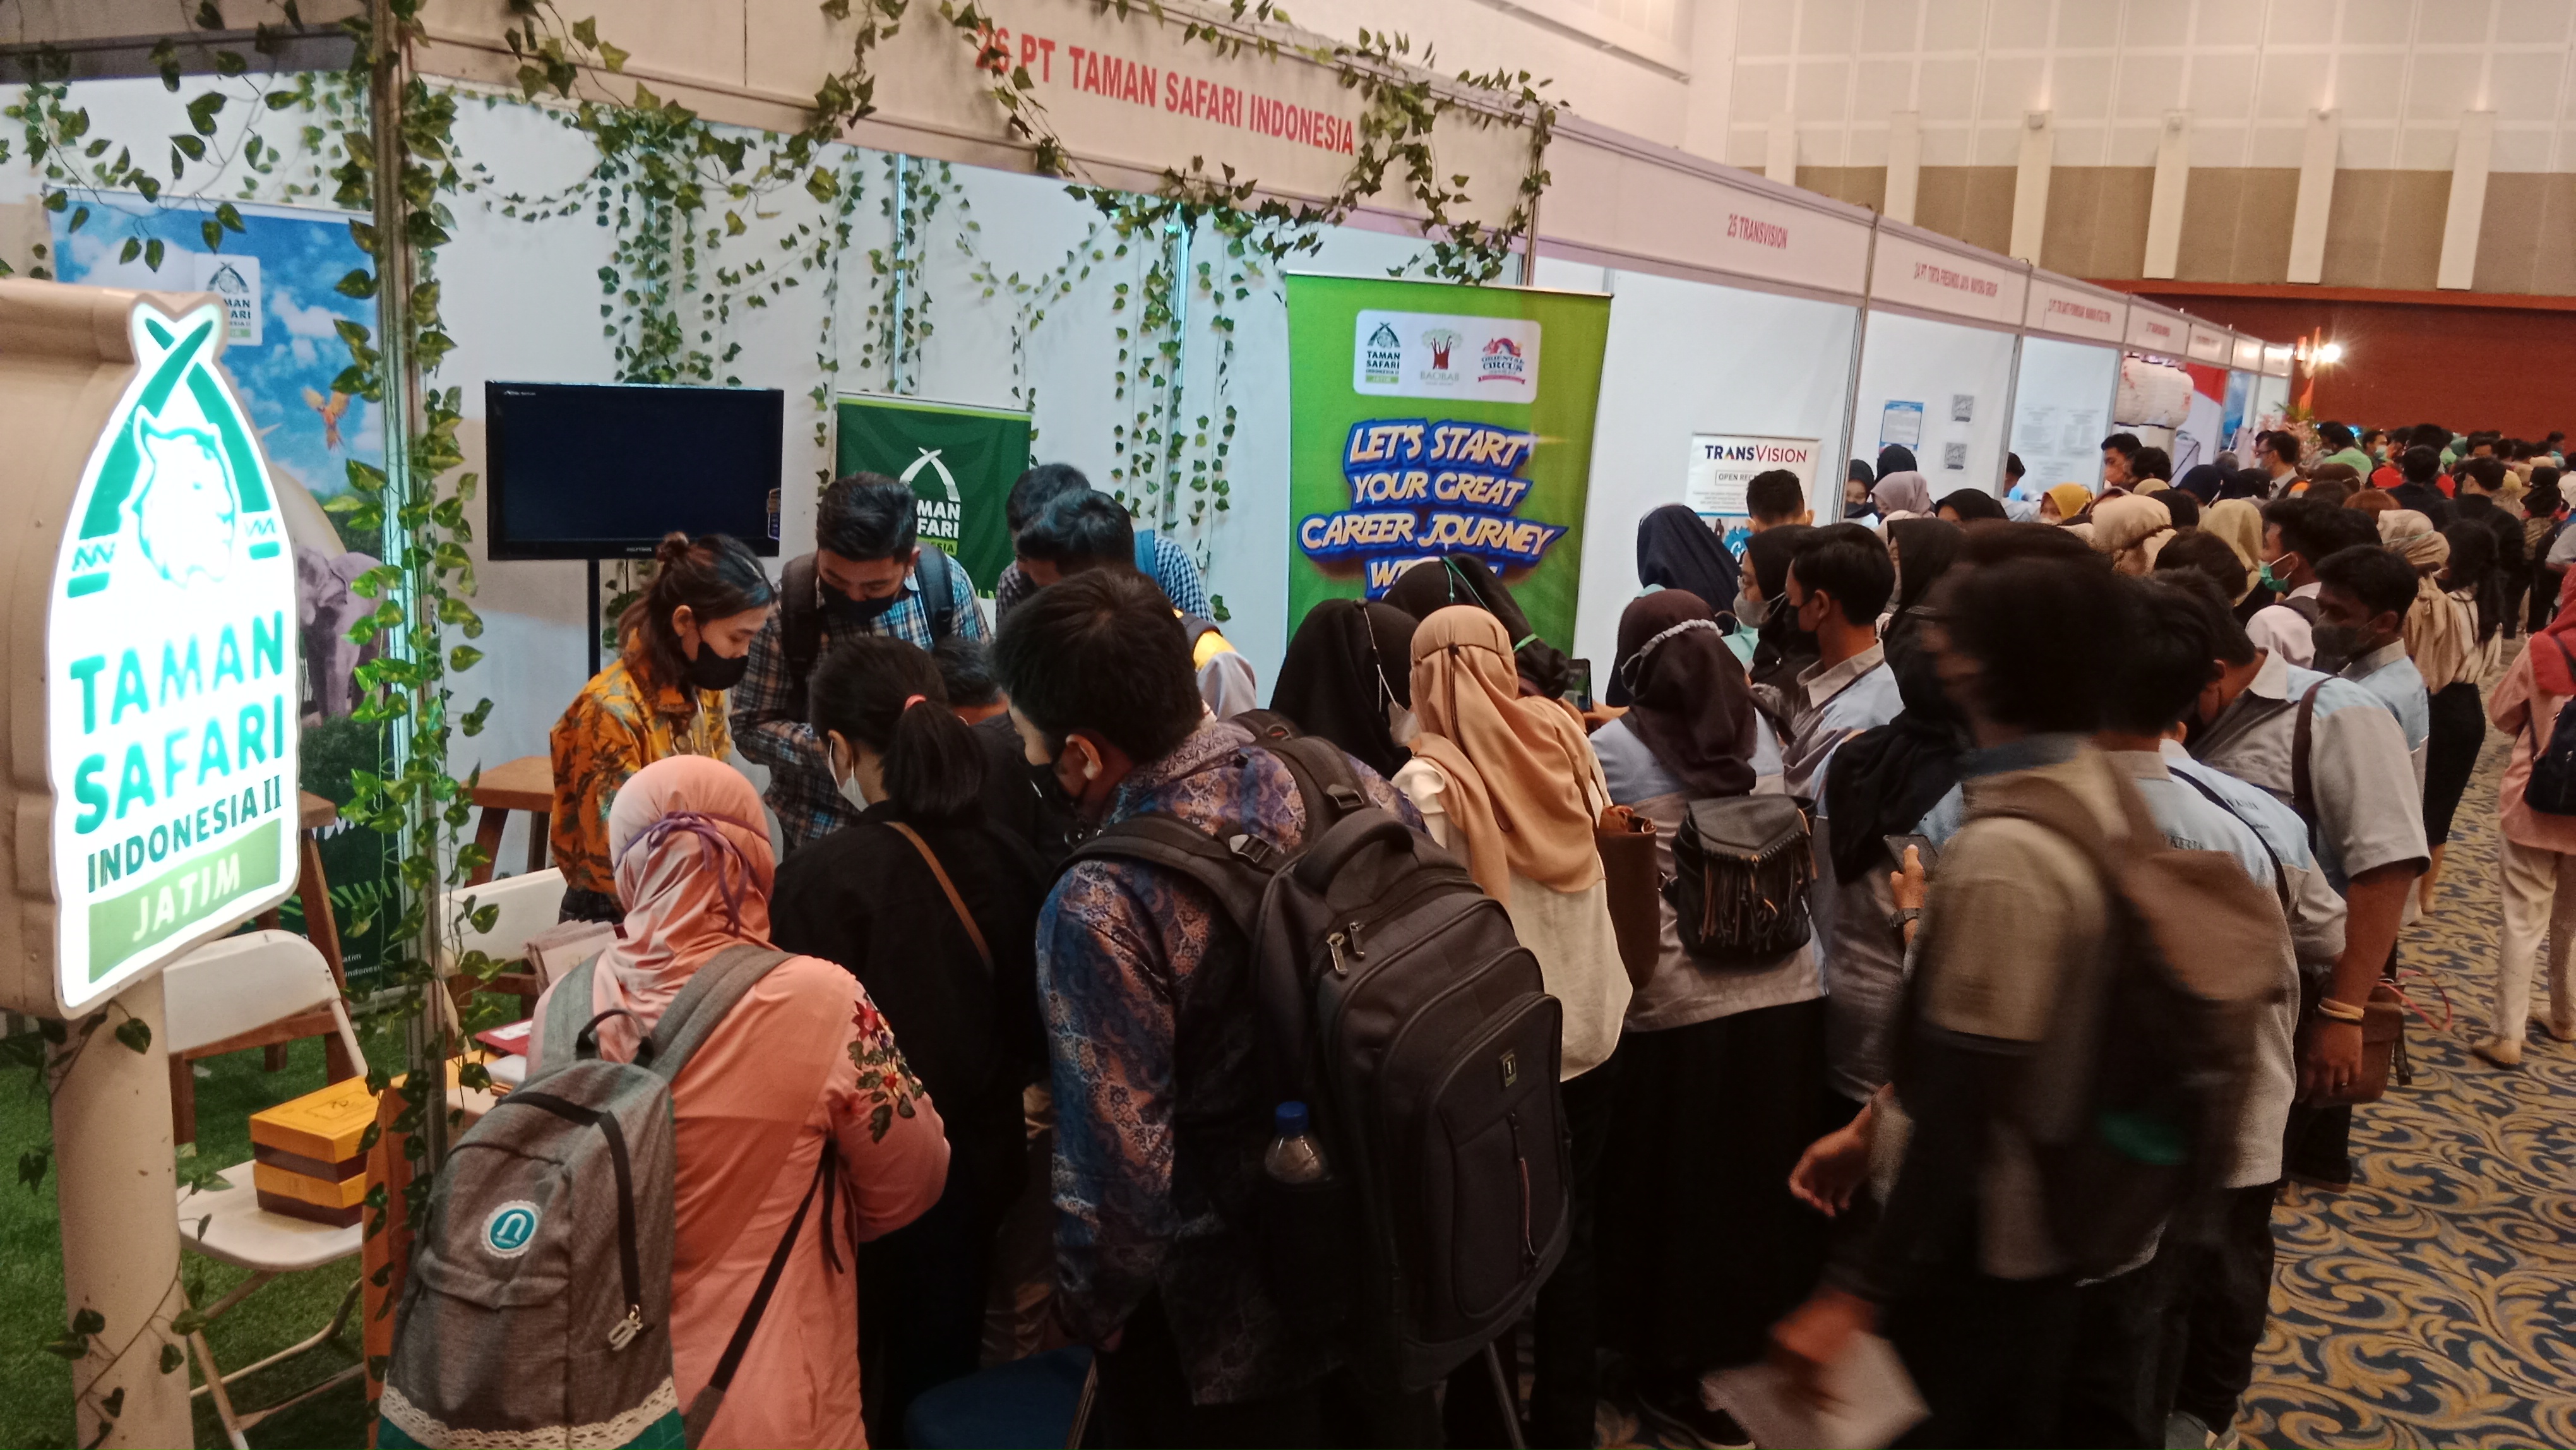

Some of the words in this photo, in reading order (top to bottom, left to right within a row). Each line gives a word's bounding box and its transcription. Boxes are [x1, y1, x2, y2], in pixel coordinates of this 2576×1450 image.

[1021, 33, 1056, 83] PT
[1069, 45, 1157, 107] TAMAN
[1165, 71, 1243, 128] SAFARI
[1249, 94, 1353, 156] INDONESIA
[1727, 213, 1738, 237] 25
[1739, 215, 1789, 249] TRANSVISION
[1366, 359, 1400, 369] SAFARI
[1367, 351, 1400, 360] TAMAN
[1481, 356, 1525, 364] ORIENTAL
[1483, 362, 1522, 371] CIRCUS
[1420, 371, 1460, 381] BAOBAB
[1350, 425, 1424, 463] LET'S
[1430, 426, 1530, 467] START
[1705, 445, 1808, 463] TRANSVISION
[1354, 471, 1429, 503] YOUR
[1434, 472, 1527, 506] GREAT
[1301, 513, 1416, 549] CAREER
[1418, 514, 1554, 555] JOURNEY
[70, 610, 283, 734] TAMAN
[75, 694, 283, 834] SAFARI
[88, 787, 258, 894] INDONESIA
[264, 775, 282, 814] II
[133, 852, 240, 942] JATIM
